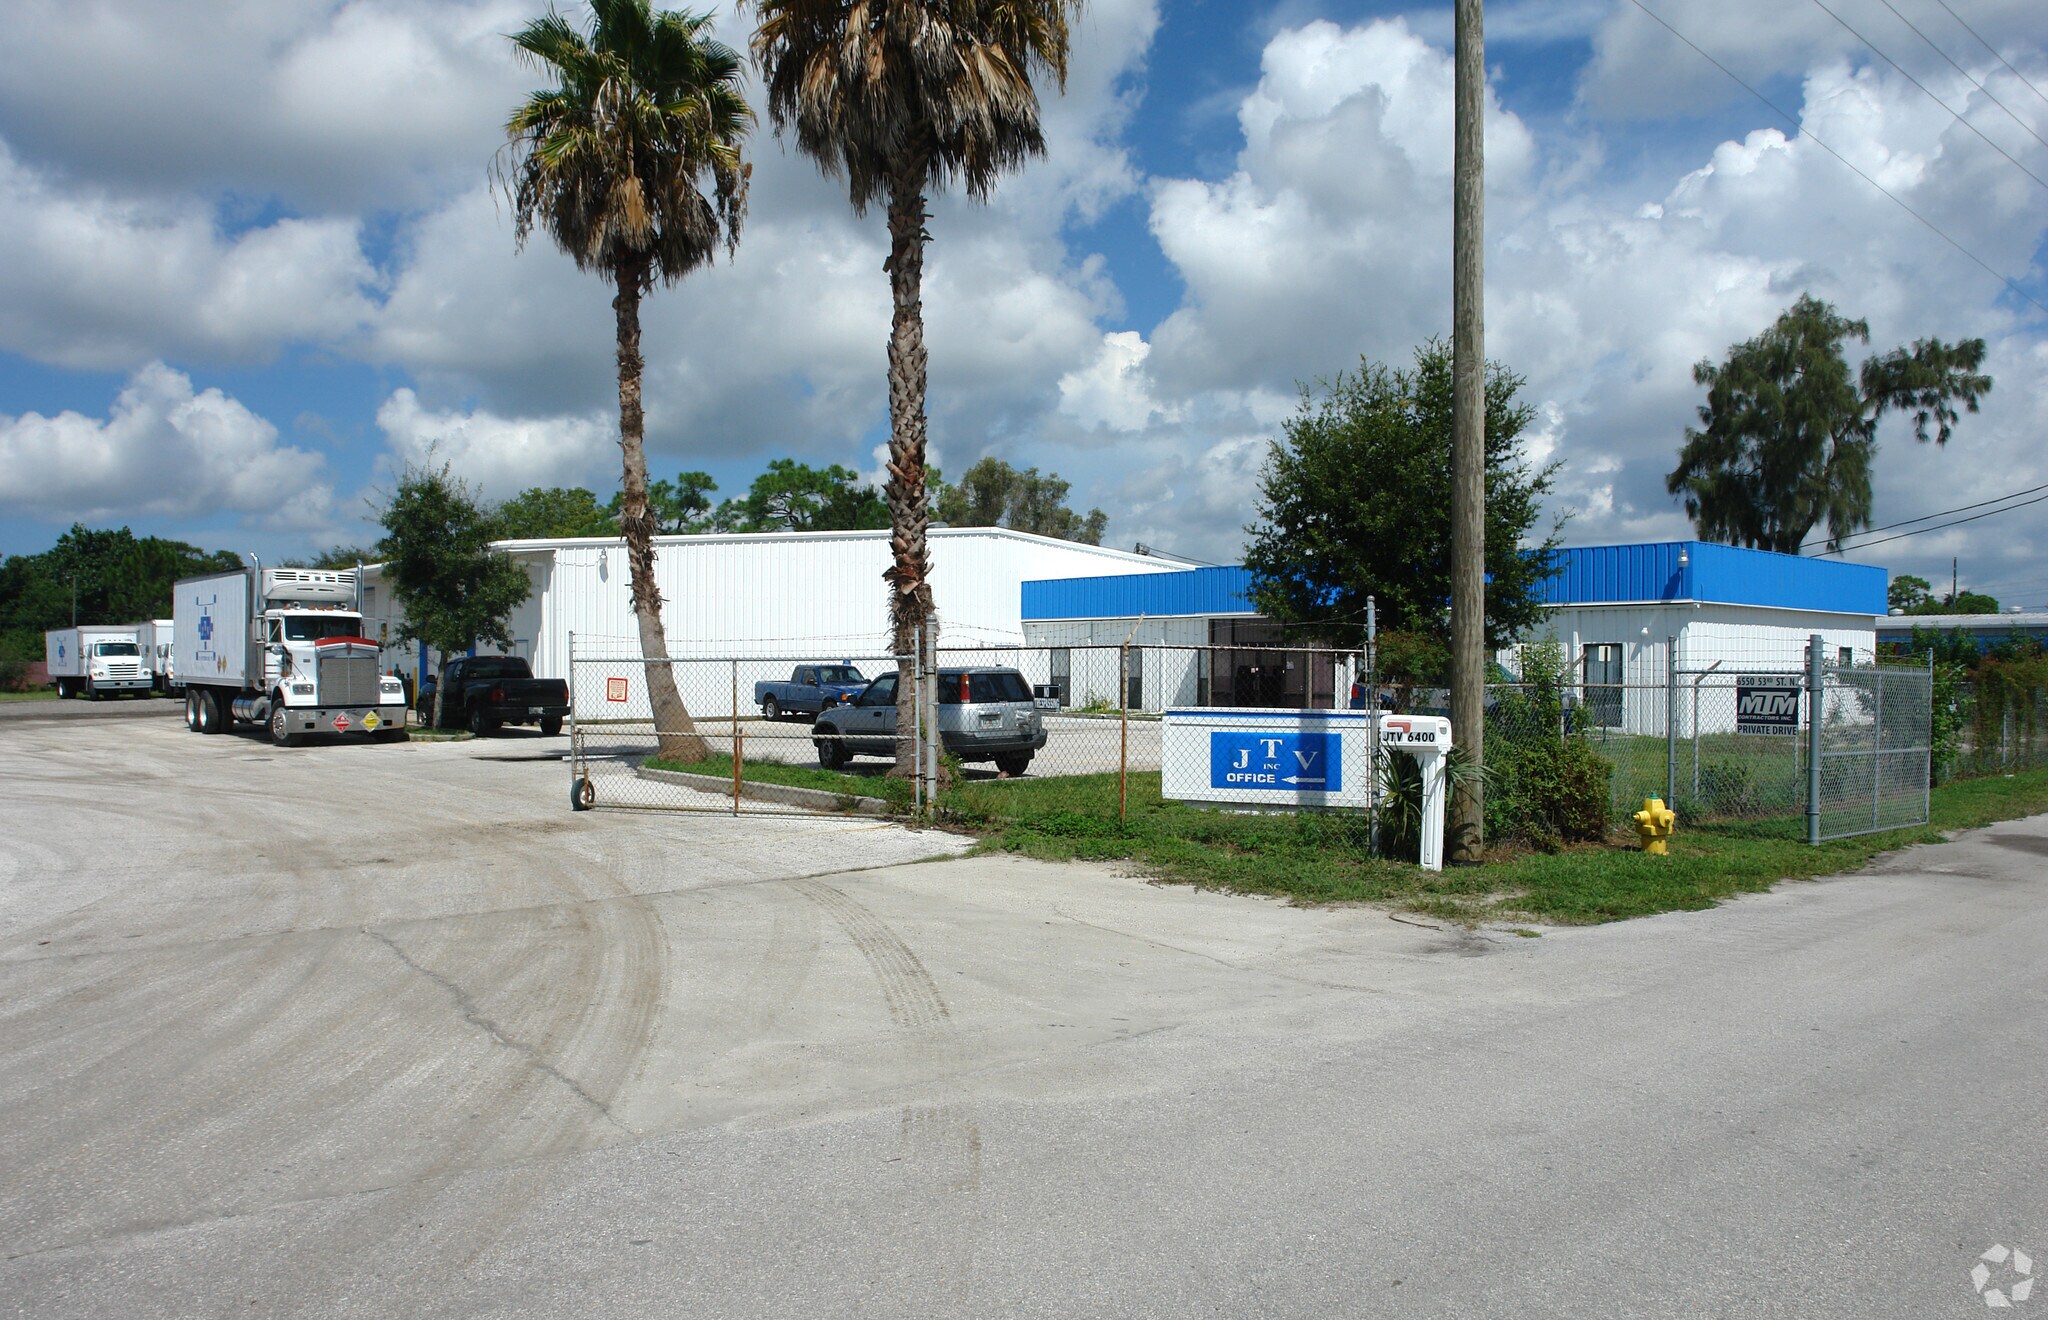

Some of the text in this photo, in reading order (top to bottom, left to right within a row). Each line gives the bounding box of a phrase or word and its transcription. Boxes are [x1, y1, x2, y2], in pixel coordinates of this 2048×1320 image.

[1737, 677, 1754, 686] 6550
[1776, 677, 1786, 686] ST.
[1738, 691, 1797, 715] MTM
[1737, 725, 1797, 735] PRIVATE DRIVE
[1383, 732, 1435, 742] JTV 6400
[1226, 772, 1276, 784] OFFICE
